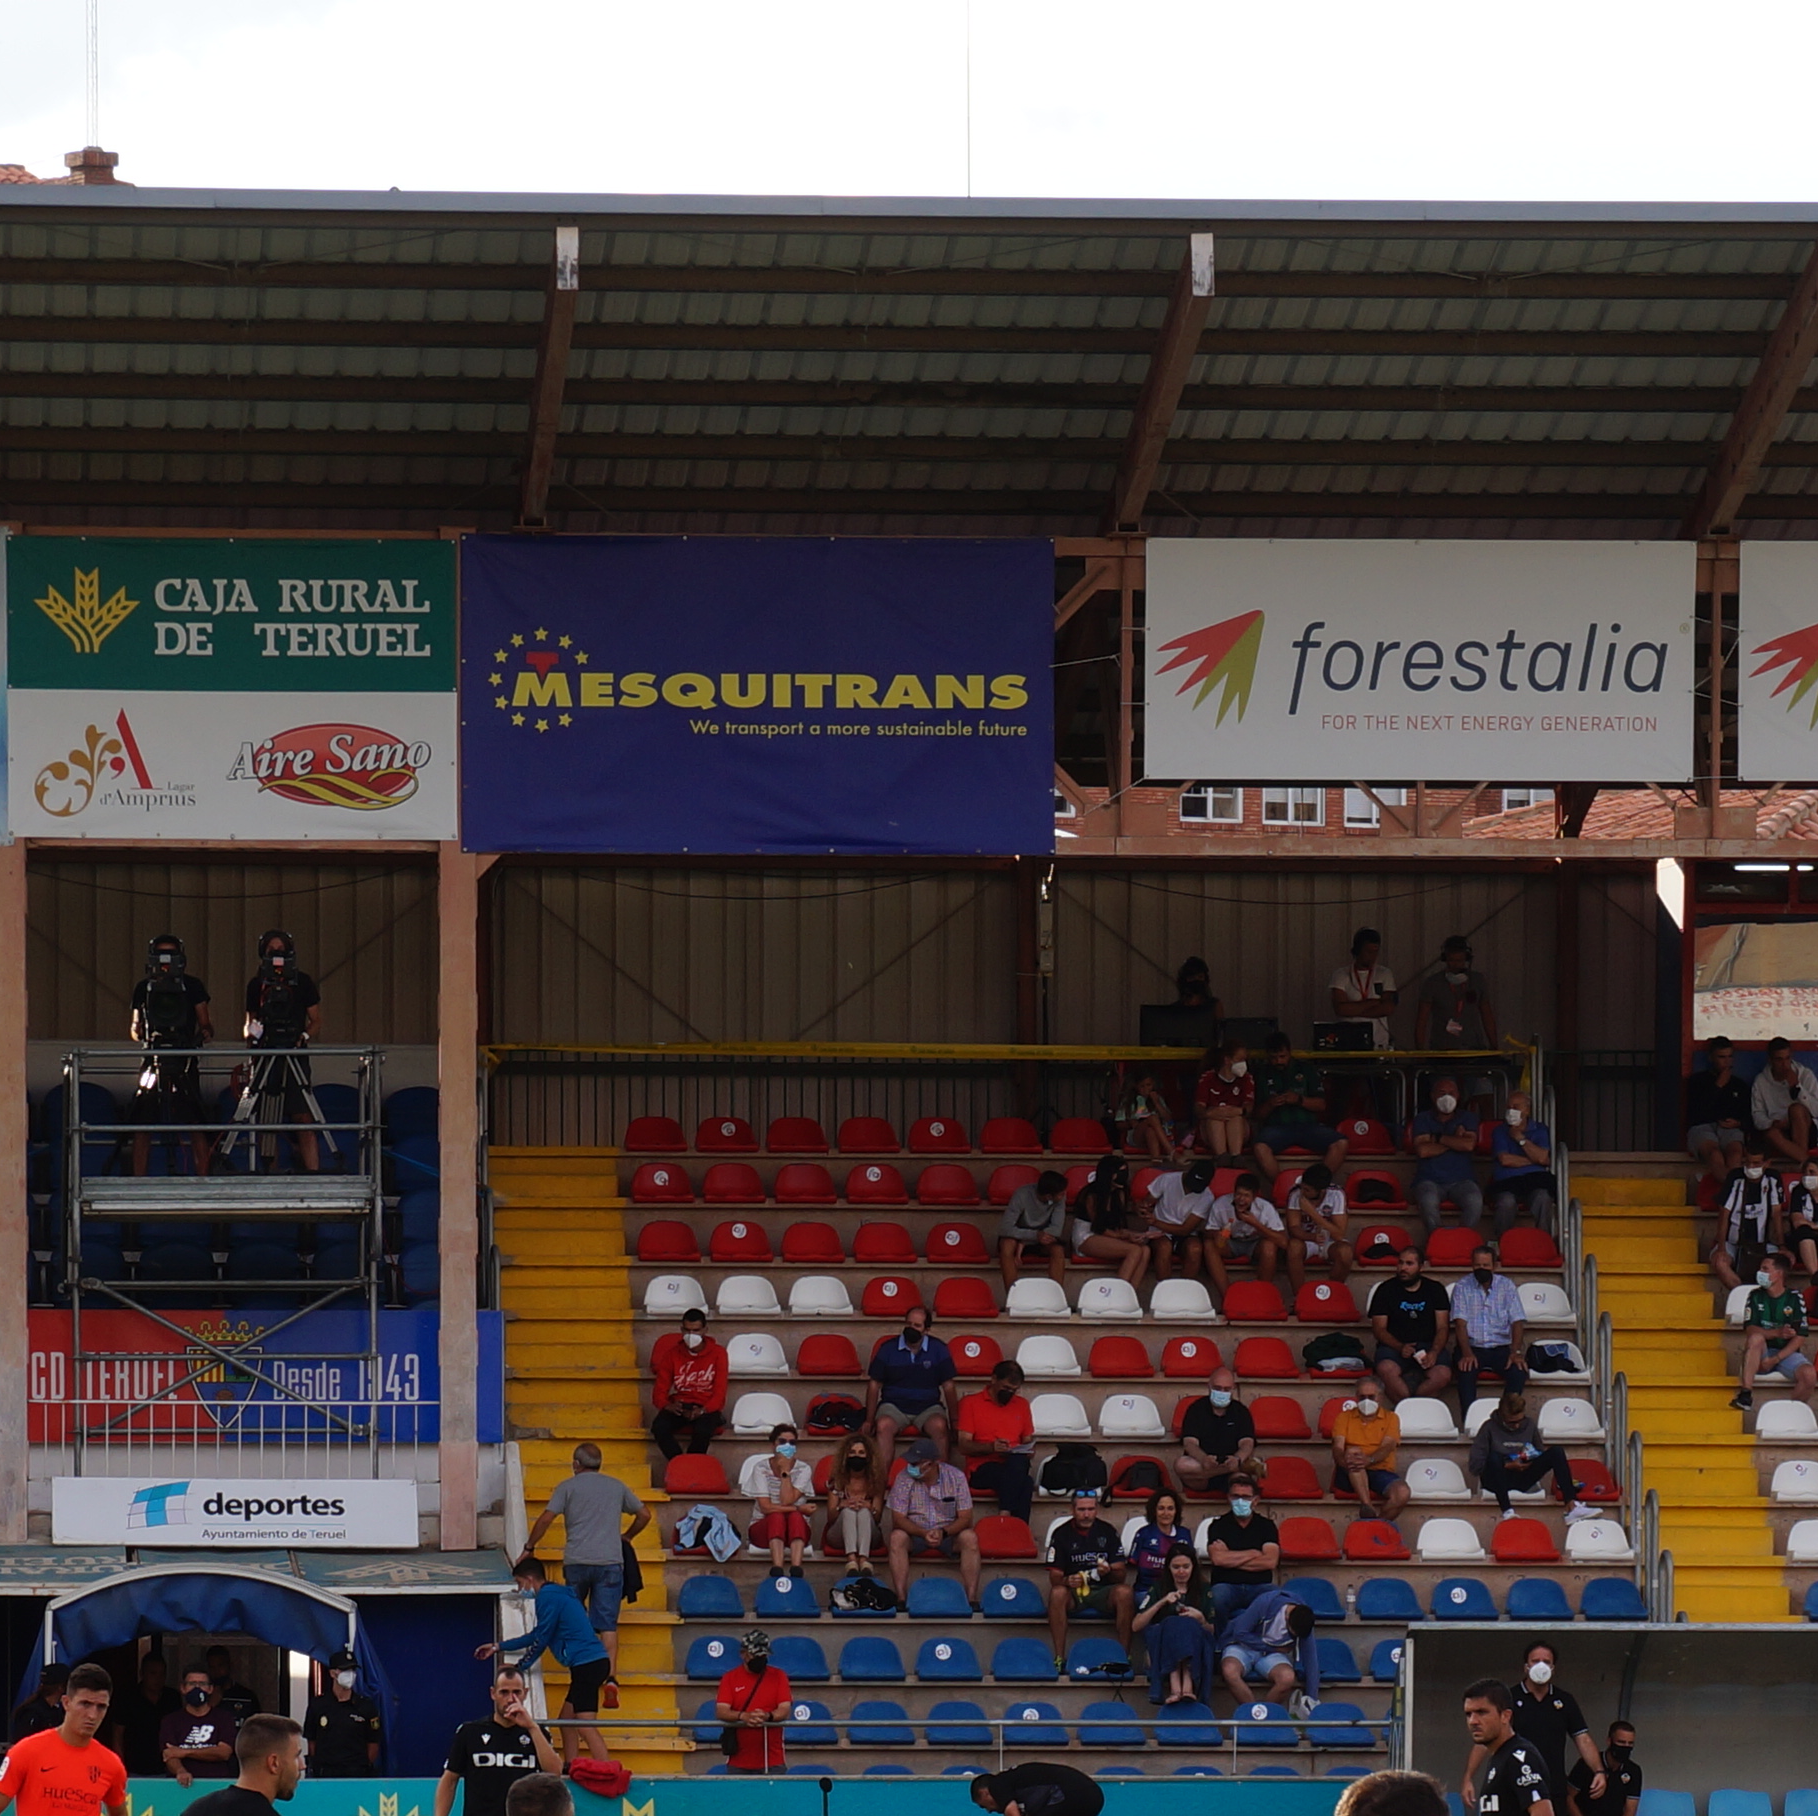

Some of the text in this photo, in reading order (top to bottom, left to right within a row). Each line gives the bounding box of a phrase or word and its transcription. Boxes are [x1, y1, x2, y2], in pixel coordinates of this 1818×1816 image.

[154, 578, 431, 616] CAJA RURAL
[154, 622, 431, 657] DE TERUEL
[1289, 622, 1669, 716] forestalia
[511, 672, 1029, 710] MESQUITRANS
[689, 719, 1028, 738] We transport a more sustainable future
[1322, 714, 1657, 732] FOR THE NEXT ENERGY GENERATION
[226, 733, 431, 780] Aire Sano
[167, 781, 195, 793] Lagar
[30, 1351, 66, 1400] CD
[85, 1351, 179, 1400] TERUEL
[273, 1360, 341, 1401] Desde
[203, 1492, 346, 1521] deportes
[201, 1529, 346, 1541] Ayuntamiento de Teruel
[472, 1752, 536, 1768] DIGI
